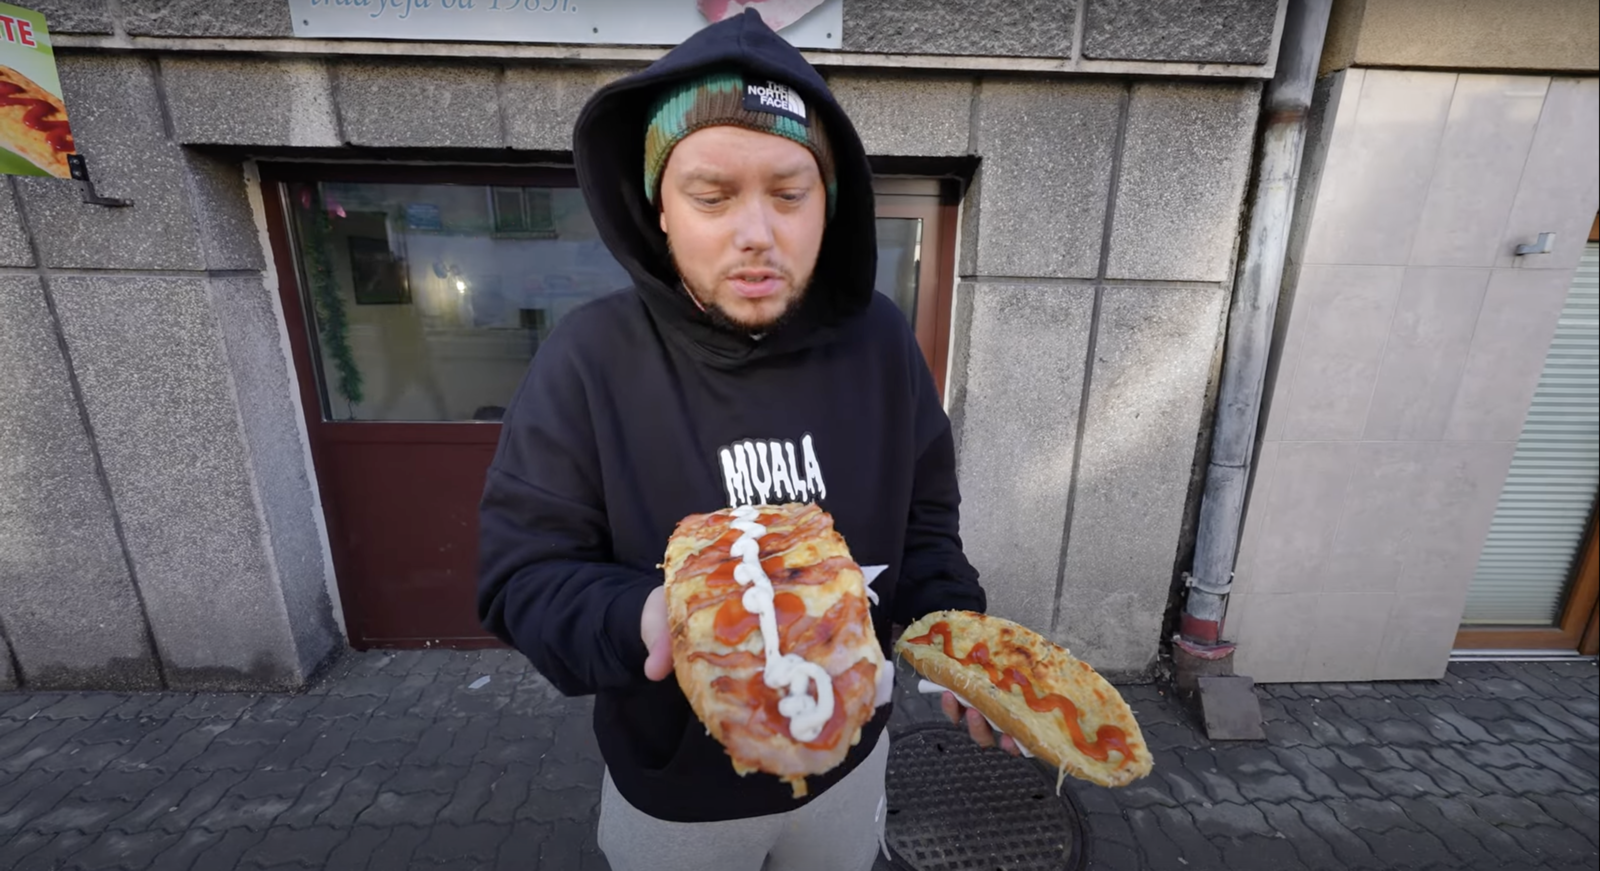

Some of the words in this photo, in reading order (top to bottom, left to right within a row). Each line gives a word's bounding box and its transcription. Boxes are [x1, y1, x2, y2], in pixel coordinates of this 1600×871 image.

[0, 15, 36, 47] TE
[747, 85, 788, 101] NORTH
[766, 80, 788, 92] THE
[760, 95, 789, 110] FACE
[719, 433, 827, 508] MUALA
